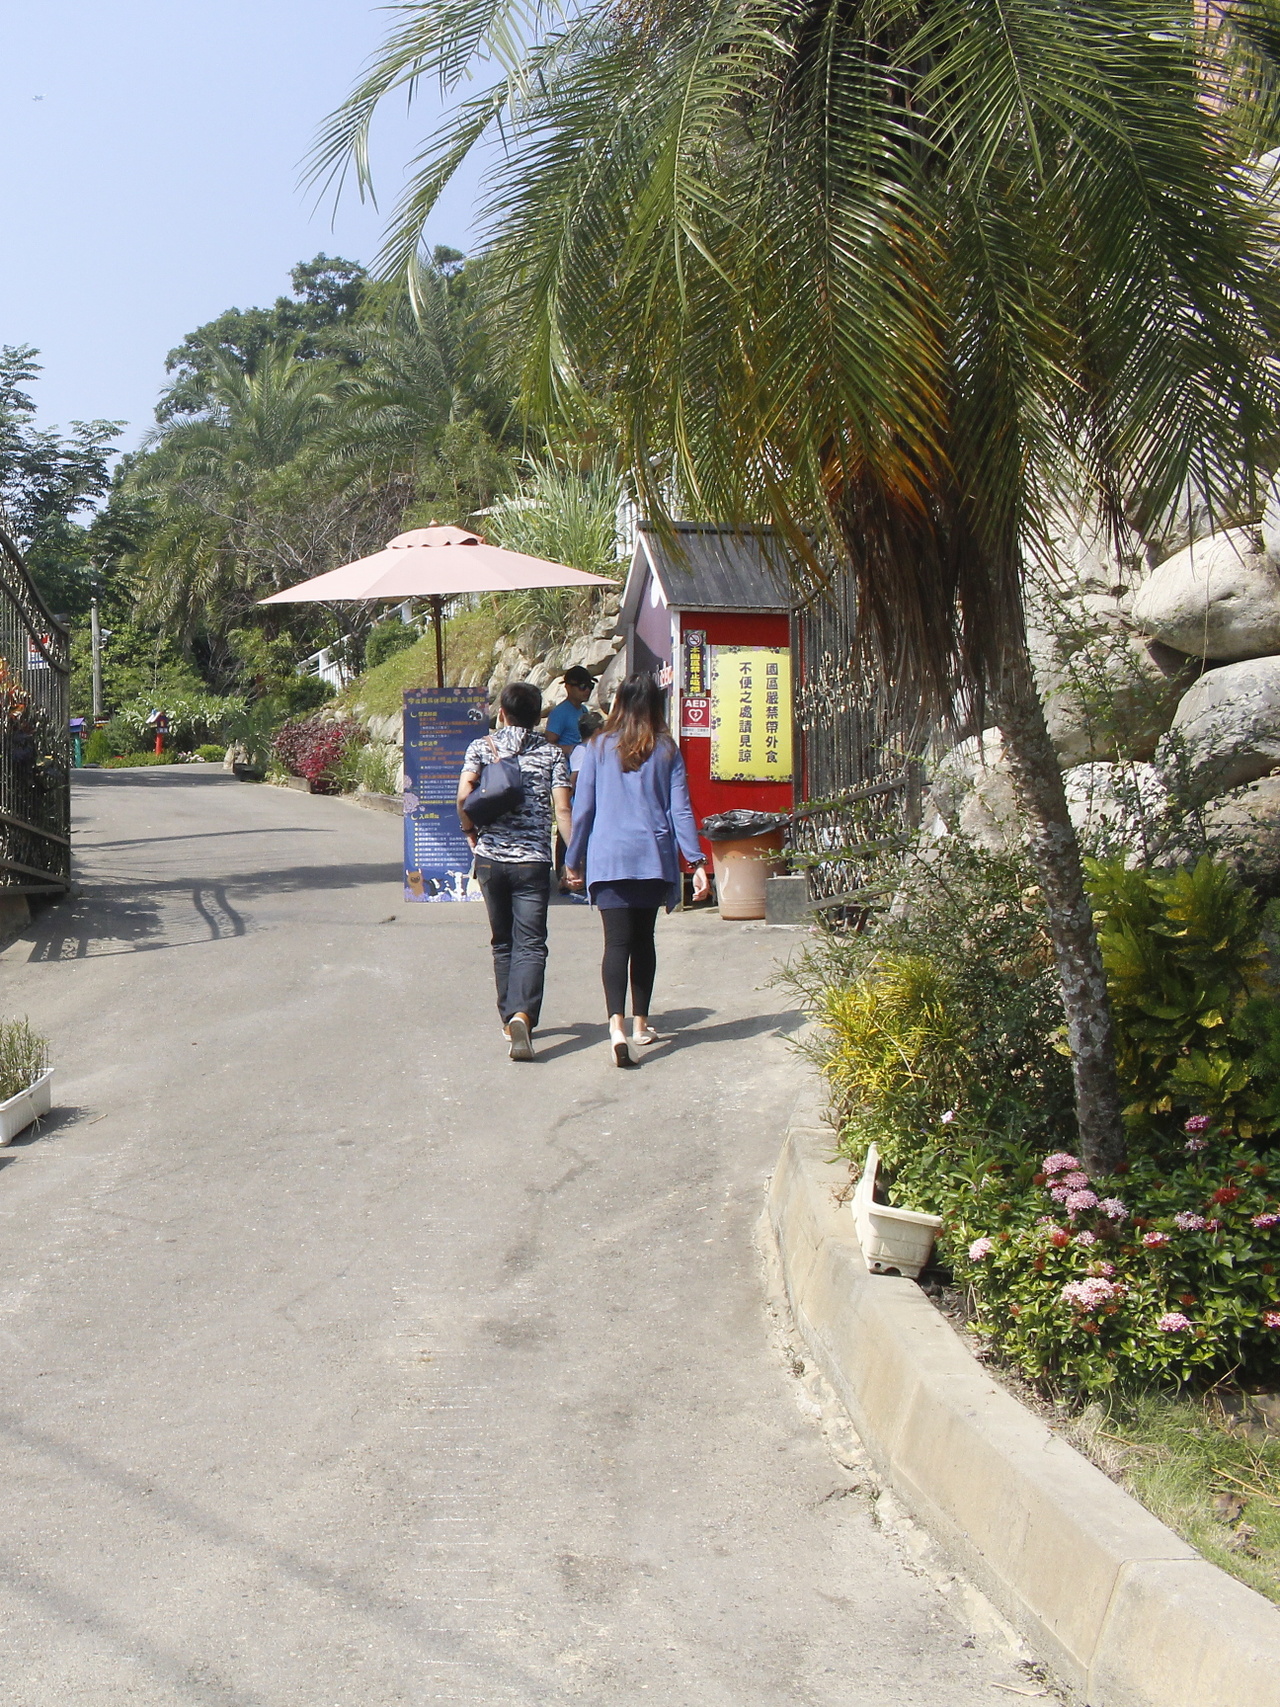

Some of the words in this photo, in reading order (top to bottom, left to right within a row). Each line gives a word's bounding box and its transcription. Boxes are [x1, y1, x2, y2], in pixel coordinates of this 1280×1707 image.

[684, 699, 707, 708] AED
[738, 662, 752, 763] 不便之處請見諒
[765, 663, 779, 763] 園區嚴禁帶外食
